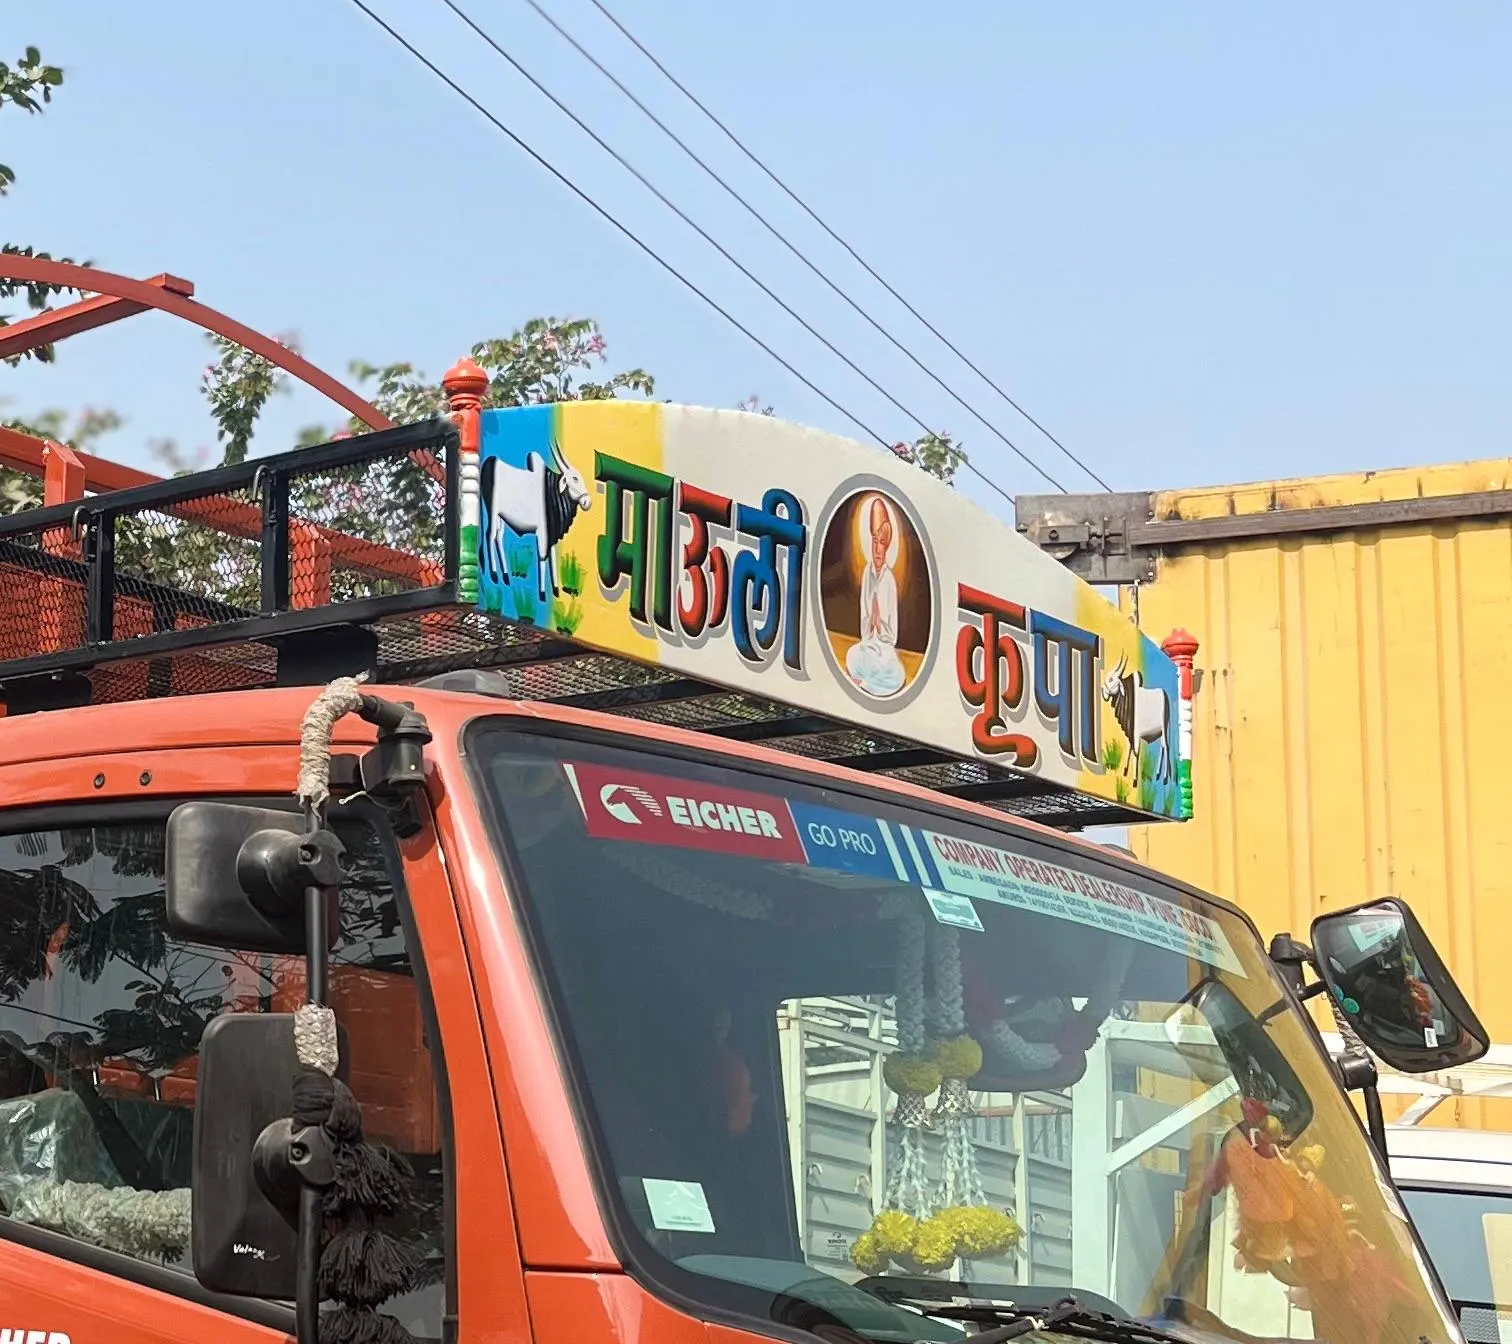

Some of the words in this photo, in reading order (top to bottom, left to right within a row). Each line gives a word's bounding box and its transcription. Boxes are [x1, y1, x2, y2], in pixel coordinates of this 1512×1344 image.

[594, 450, 807, 672] माऊली
[956, 582, 1100, 769] कृपा
[665, 795, 782, 839] EICHER
[808, 822, 837, 848] GO
[840, 828, 877, 855] PRO
[933, 835, 1006, 875] COMPANY
[1004, 853, 1076, 893] OPERATED
[1072, 872, 1147, 915] DEALERSHIP
